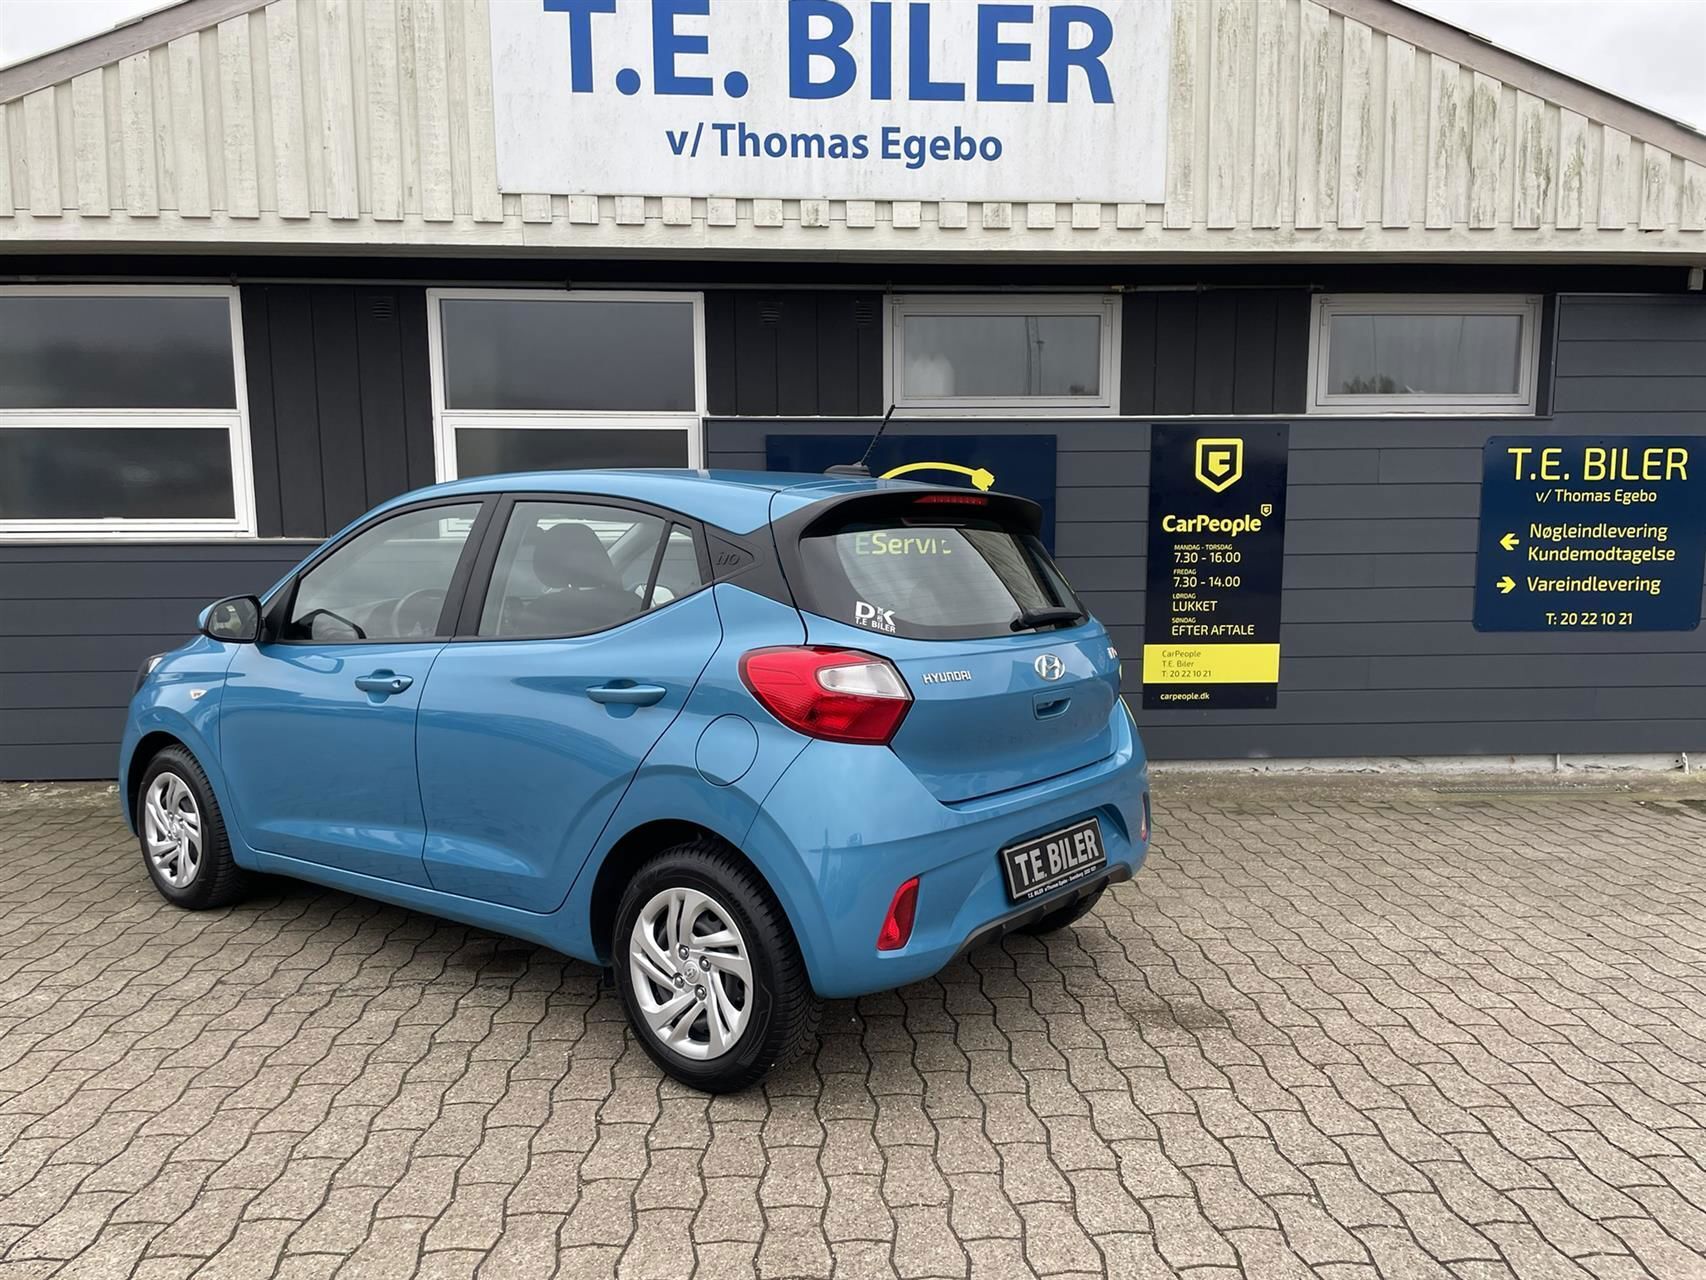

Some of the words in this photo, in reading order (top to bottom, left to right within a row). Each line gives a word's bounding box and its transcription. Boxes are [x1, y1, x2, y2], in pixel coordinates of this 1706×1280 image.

[544, 0, 748, 98] T.E.
[788, 0, 1114, 104] BILER
[666, 123, 704, 158] v/
[712, 123, 868, 159] Thomas
[881, 126, 1003, 169] Egebo
[1507, 448, 1569, 480] T.E.
[1583, 448, 1689, 480] BILER
[1536, 489, 1552, 502] v/
[1556, 489, 1610, 502] Thomas
[1614, 490, 1657, 504] Egebo
[1163, 514, 1261, 536] CarPeople
[1530, 524, 1668, 541] Nøgleindlevering
[1174, 552, 1198, 562] 7.30
[1210, 552, 1241, 562] 16.00
[1528, 547, 1675, 563] Kundemodtagelse
[1174, 577, 1197, 587] 7.30
[1209, 577, 1240, 587] 14.00
[1528, 577, 1660, 594] Vareindlevering
[1173, 601, 1217, 611] LUKKET
[1546, 613, 1557, 625] T:
[1560, 613, 1577, 625] 20
[1581, 613, 1597, 625] 22
[1601, 613, 1616, 625] 10
[1619, 613, 1632, 625] 21
[872, 621, 896, 633] BILER
[1172, 626, 1208, 635] EFTER
[1211, 625, 1254, 635] AFTALE
[923, 671, 971, 684] HYUNDAI
[1161, 693, 1209, 701] carpeople.dk
[1047, 830, 1099, 874] BILER
